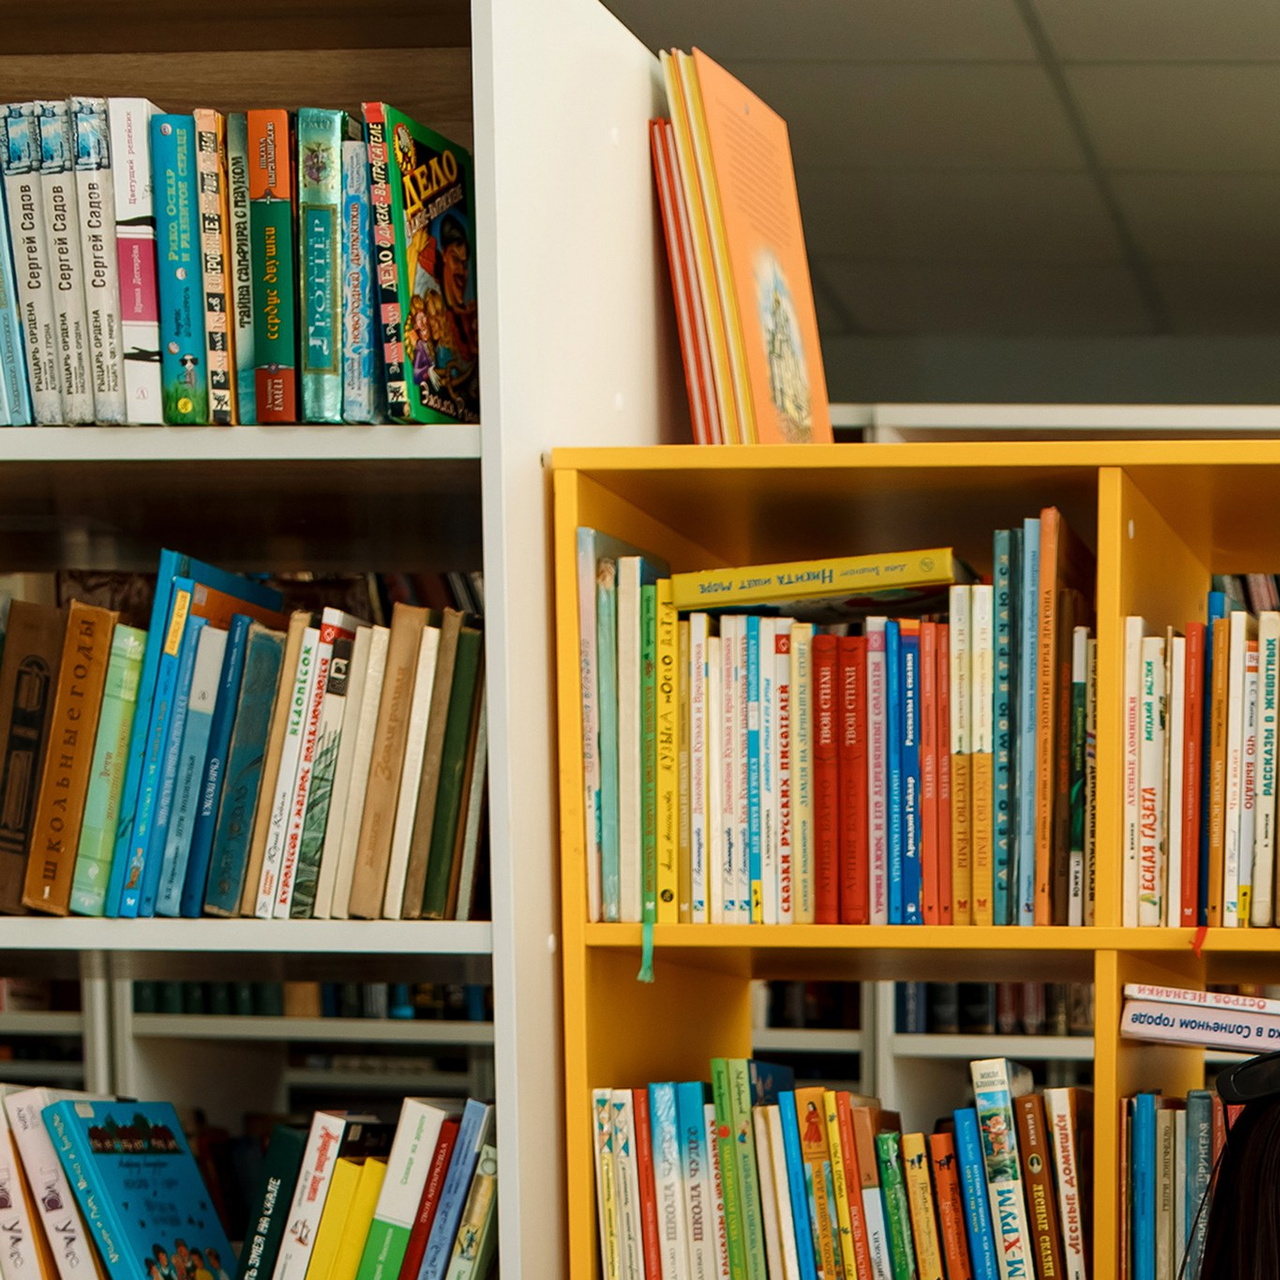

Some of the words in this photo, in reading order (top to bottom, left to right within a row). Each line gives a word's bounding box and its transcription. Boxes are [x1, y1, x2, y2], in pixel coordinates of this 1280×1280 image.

[20, 185, 35, 231] Садов
[88, 182, 103, 229] Садов
[403, 150, 458, 212] ДЕЛО
[53, 186, 67, 231] Садов
[22, 236, 42, 290] Сергей
[54, 237, 72, 291] Сергей
[88, 235, 108, 288] Сергей
[1266, 639, 1276, 710] ЖИВОТНЫХ
[1263, 728, 1274, 796] РАССКАЗЫ
[1140, 786, 1156, 840] ГАЗЕТА
[1140, 842, 1157, 906] ЛЕСНАЯ
[1131, 1012, 1175, 1031] городе
[1179, 1017, 1251, 1039] Солнечном
[1056, 1113, 1077, 1188] ДОМИШКИ
[1033, 1184, 1049, 1231] ЛЕСНЫЕ
[1066, 1193, 1082, 1254] ЛЕСНЫЕ
[1040, 1234, 1054, 1277] СКАЗКИ
